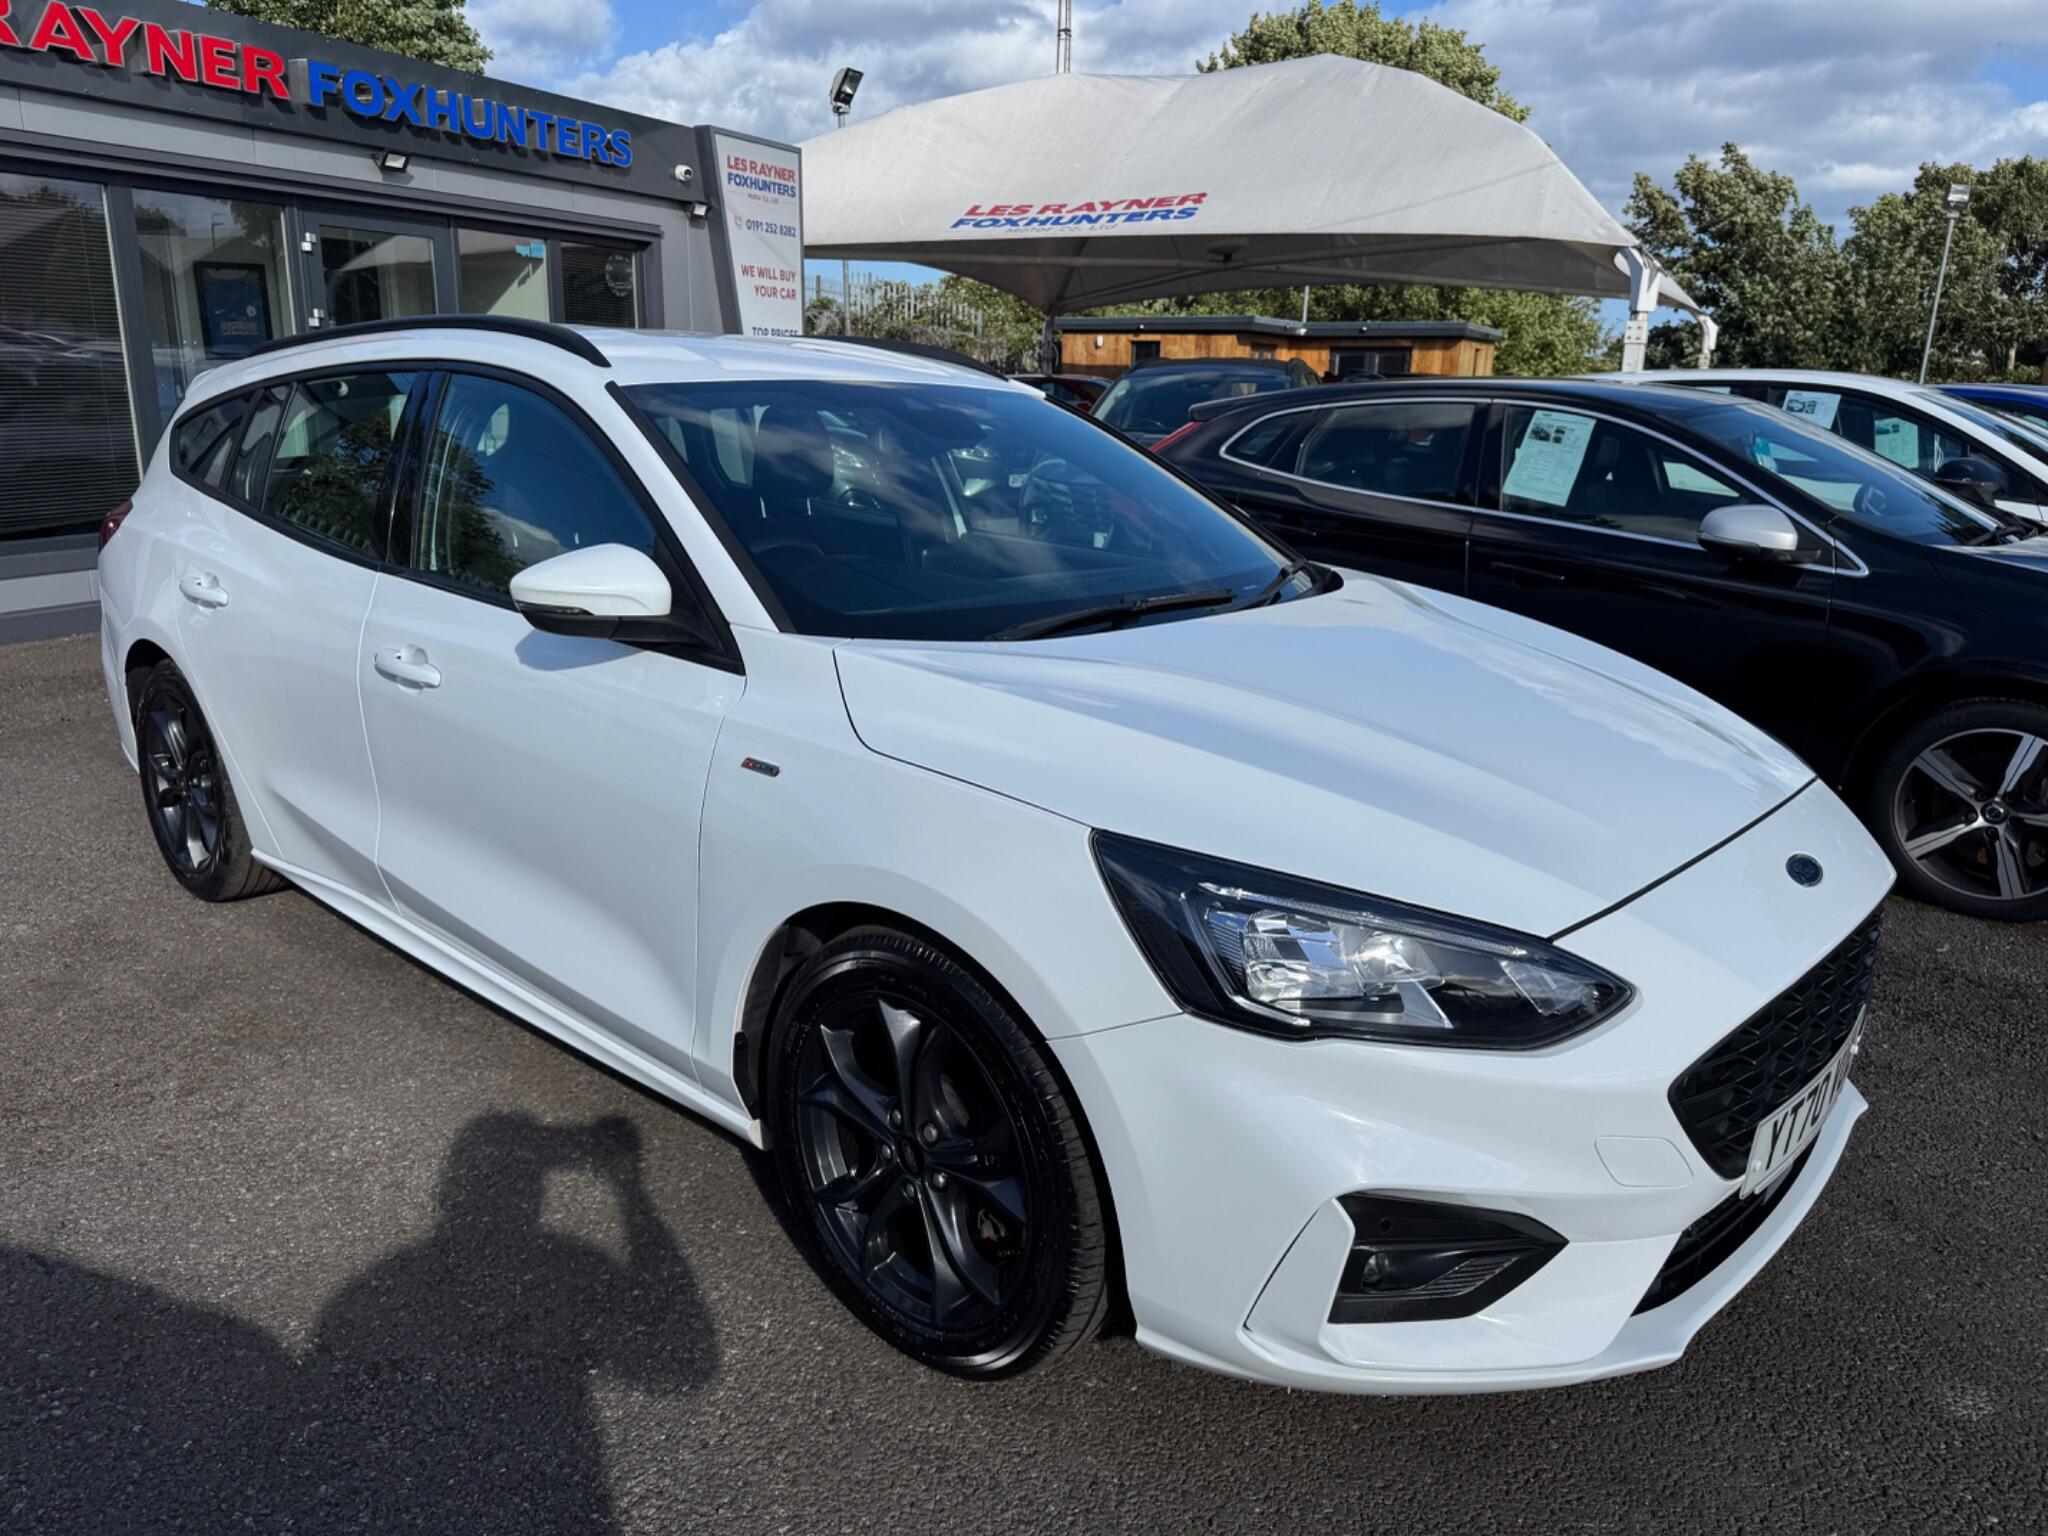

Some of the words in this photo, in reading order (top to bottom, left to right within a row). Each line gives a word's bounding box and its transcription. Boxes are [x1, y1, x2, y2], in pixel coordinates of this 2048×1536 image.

[306, 59, 634, 168] FOXHUNTERS
[727, 154, 748, 172] LES
[749, 160, 796, 183] RAYNER
[727, 172, 797, 198] FOXHUNTERS
[965, 204, 1034, 216] LES
[1036, 192, 1208, 215] RAYNER
[745, 218, 764, 232] 0191
[765, 222, 778, 235] 252
[779, 224, 797, 238] 8282
[950, 207, 1199, 228] FOXHUNTERS
[741, 264, 756, 278] WE
[757, 266, 778, 281] WILL
[779, 269, 797, 283] BUY
[754, 285, 778, 299] YOUR
[779, 287, 797, 301] CAR
[1765, 1069, 1833, 1171] YT70
